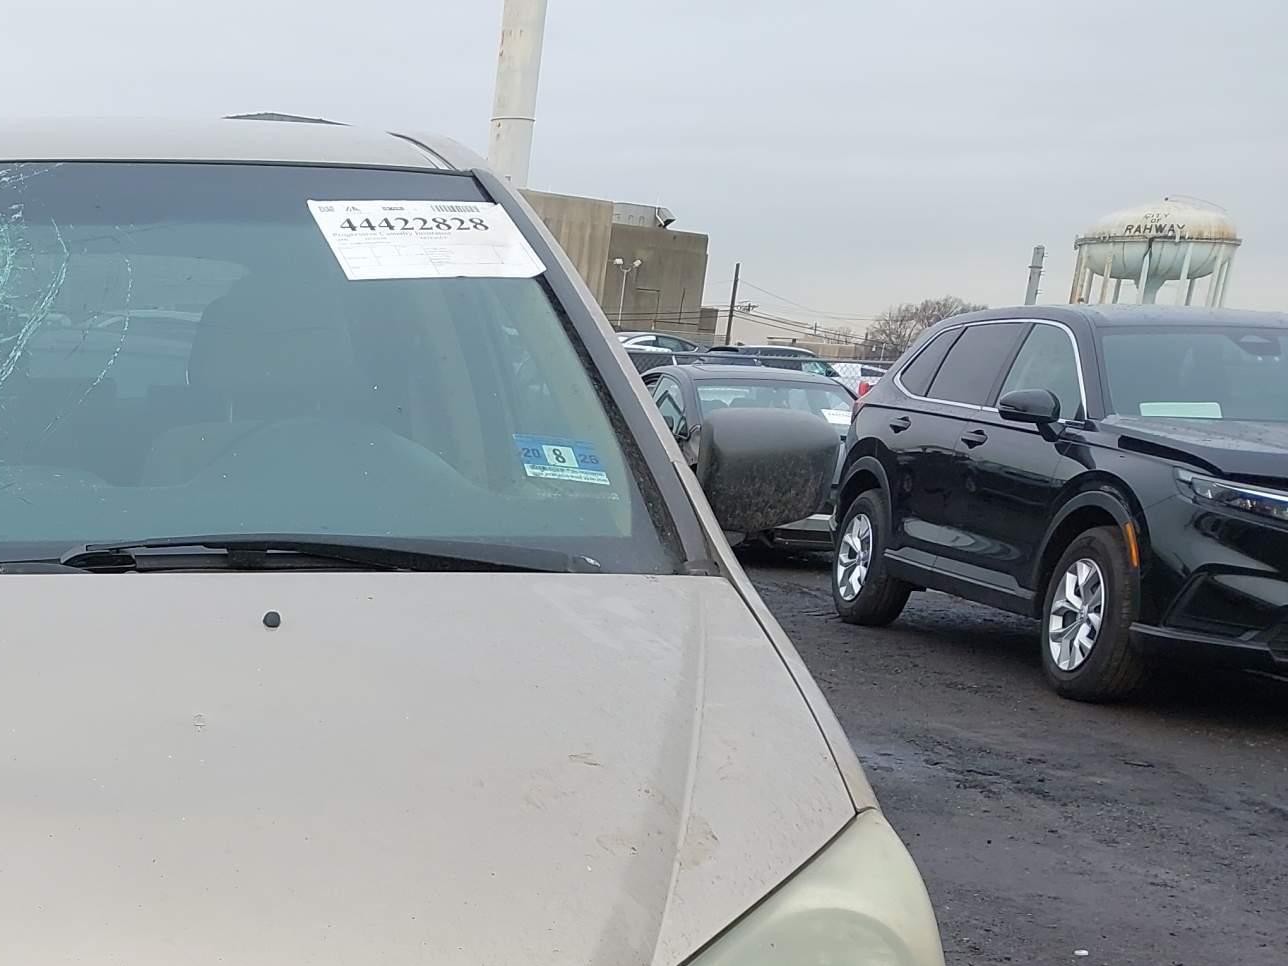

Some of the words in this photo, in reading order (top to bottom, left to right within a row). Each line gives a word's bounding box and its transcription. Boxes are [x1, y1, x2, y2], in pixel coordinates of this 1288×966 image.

[339, 216, 490, 232] 44422828
[1124, 223, 1186, 234] RAHWAY
[521, 447, 541, 458] 20
[552, 448, 567, 464] 8
